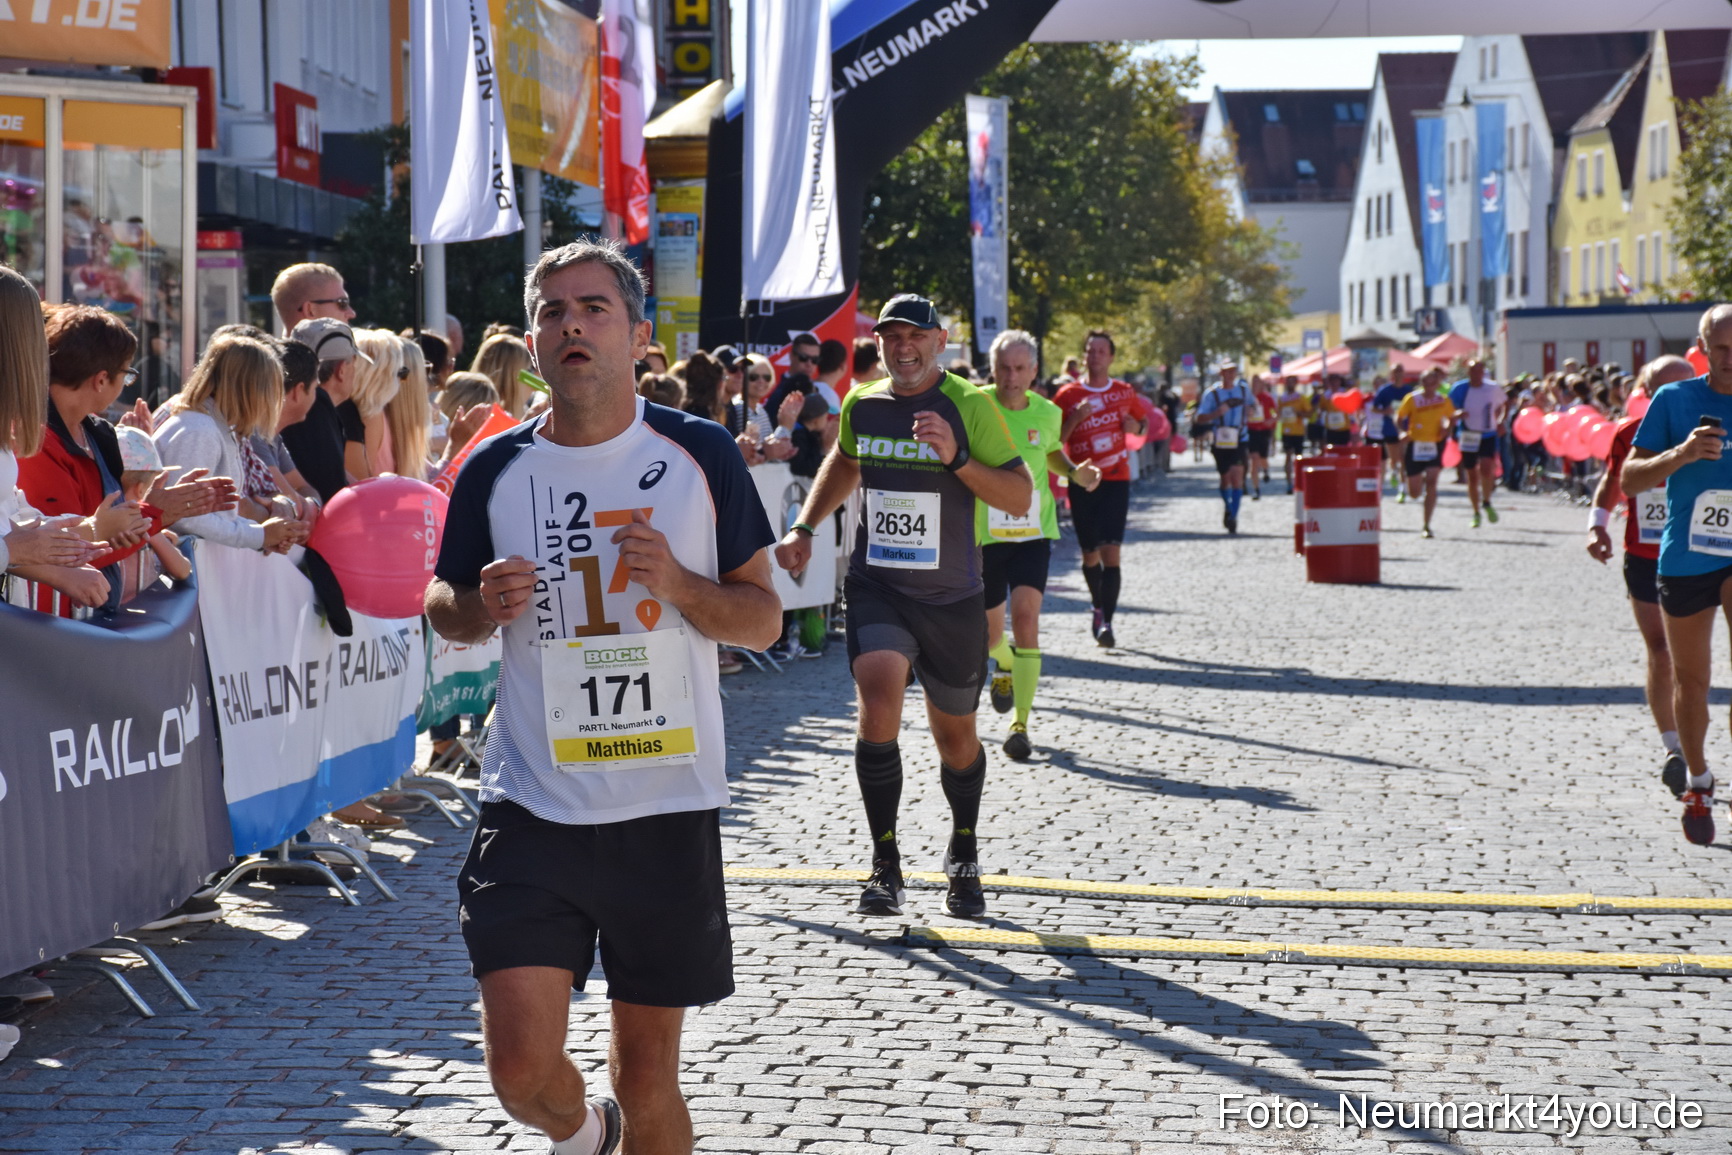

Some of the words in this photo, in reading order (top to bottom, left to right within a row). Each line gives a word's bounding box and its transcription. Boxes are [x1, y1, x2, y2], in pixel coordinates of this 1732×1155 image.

[0, 114, 24, 131] DE
[808, 96, 826, 212] NEUMARKT
[857, 435, 941, 462] BOCK
[884, 498, 915, 508] BOCK
[875, 511, 927, 537] 2634
[1702, 506, 1732, 527] 26
[882, 548, 916, 560] Markus
[338, 627, 411, 688] RAIL.ONE
[584, 646, 648, 664] BOCK
[219, 660, 319, 726] RAIL.ONE
[580, 672, 651, 716] 171
[578, 724, 609, 732] PARTL
[611, 719, 653, 731] Neumarkt
[586, 739, 663, 758] Matthias
